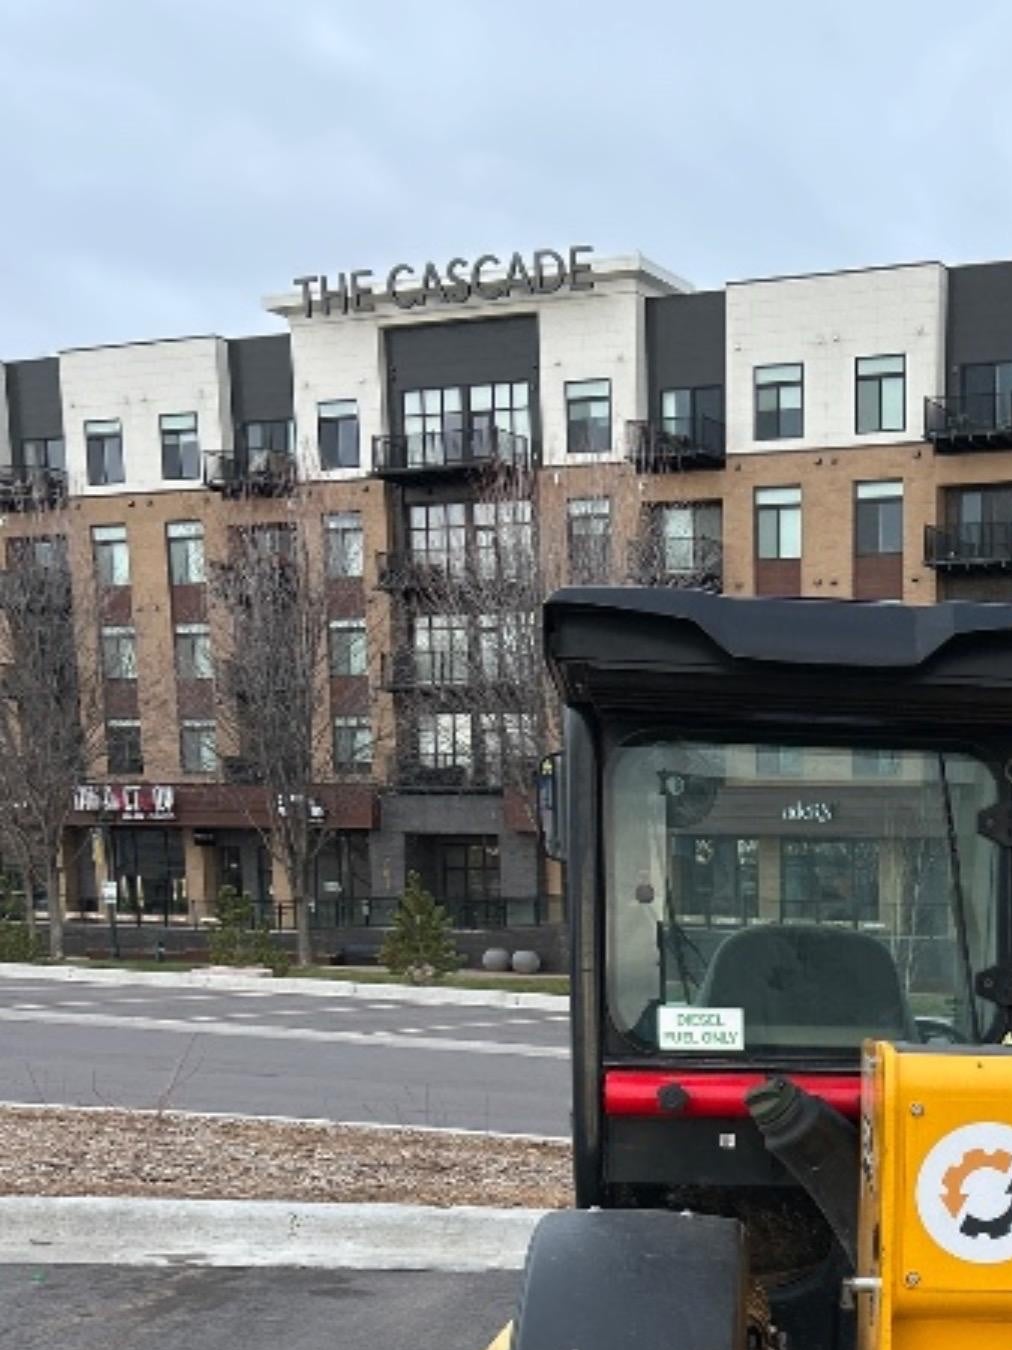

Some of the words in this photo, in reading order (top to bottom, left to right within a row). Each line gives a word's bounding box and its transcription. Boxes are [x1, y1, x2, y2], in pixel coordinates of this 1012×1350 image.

[293, 269, 376, 318] THE
[386, 245, 595, 309] CASCADE
[701, 1031, 739, 1045] ONLY
